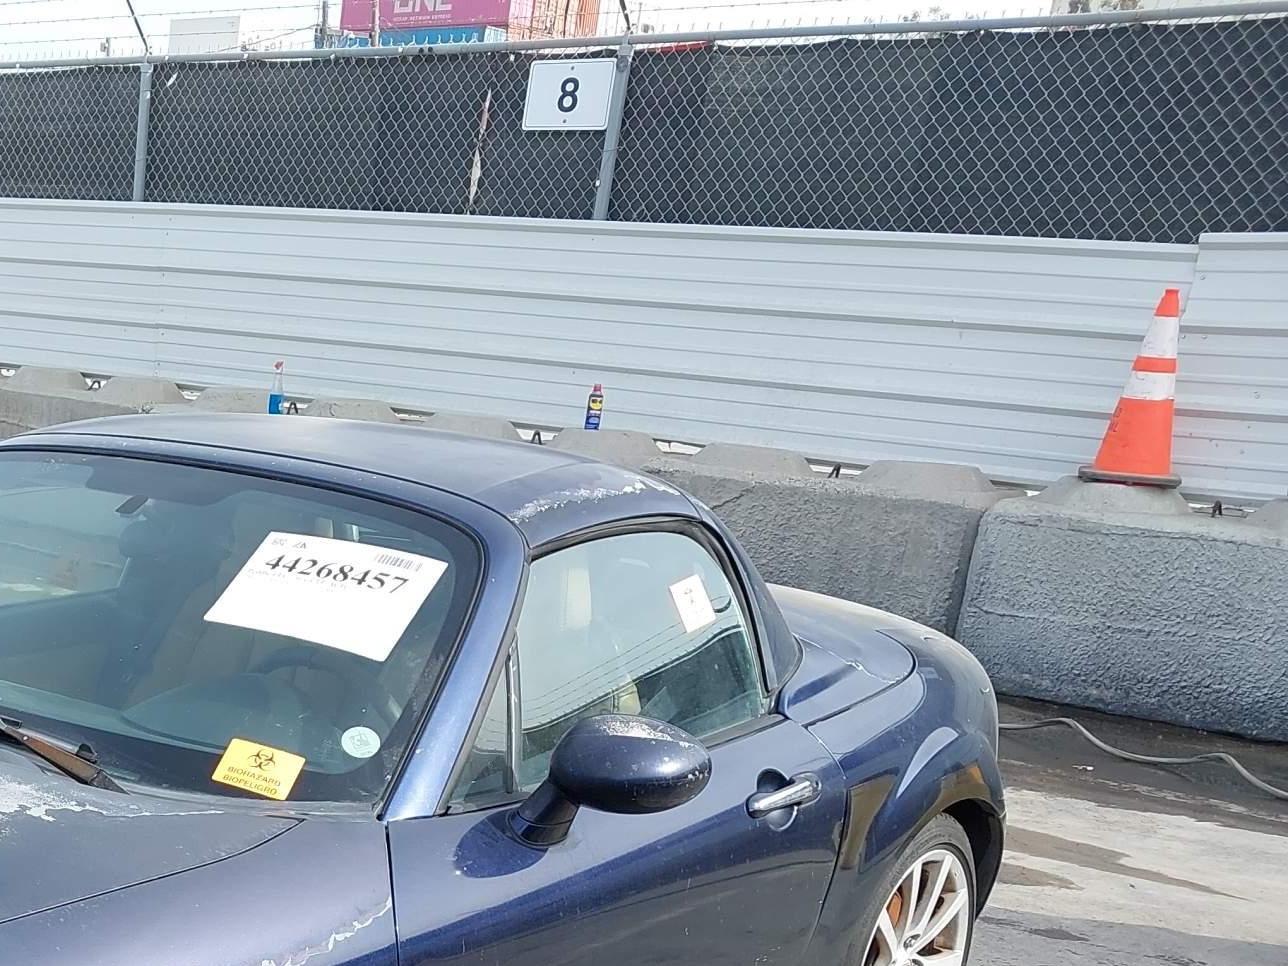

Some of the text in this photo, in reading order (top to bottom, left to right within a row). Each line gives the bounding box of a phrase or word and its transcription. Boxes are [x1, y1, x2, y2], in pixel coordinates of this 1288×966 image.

[557, 77, 579, 113] 8
[265, 554, 409, 593] 44268457
[222, 774, 278, 796] BIOPELIGRO
[227, 765, 281, 787] BIOHAZARD
